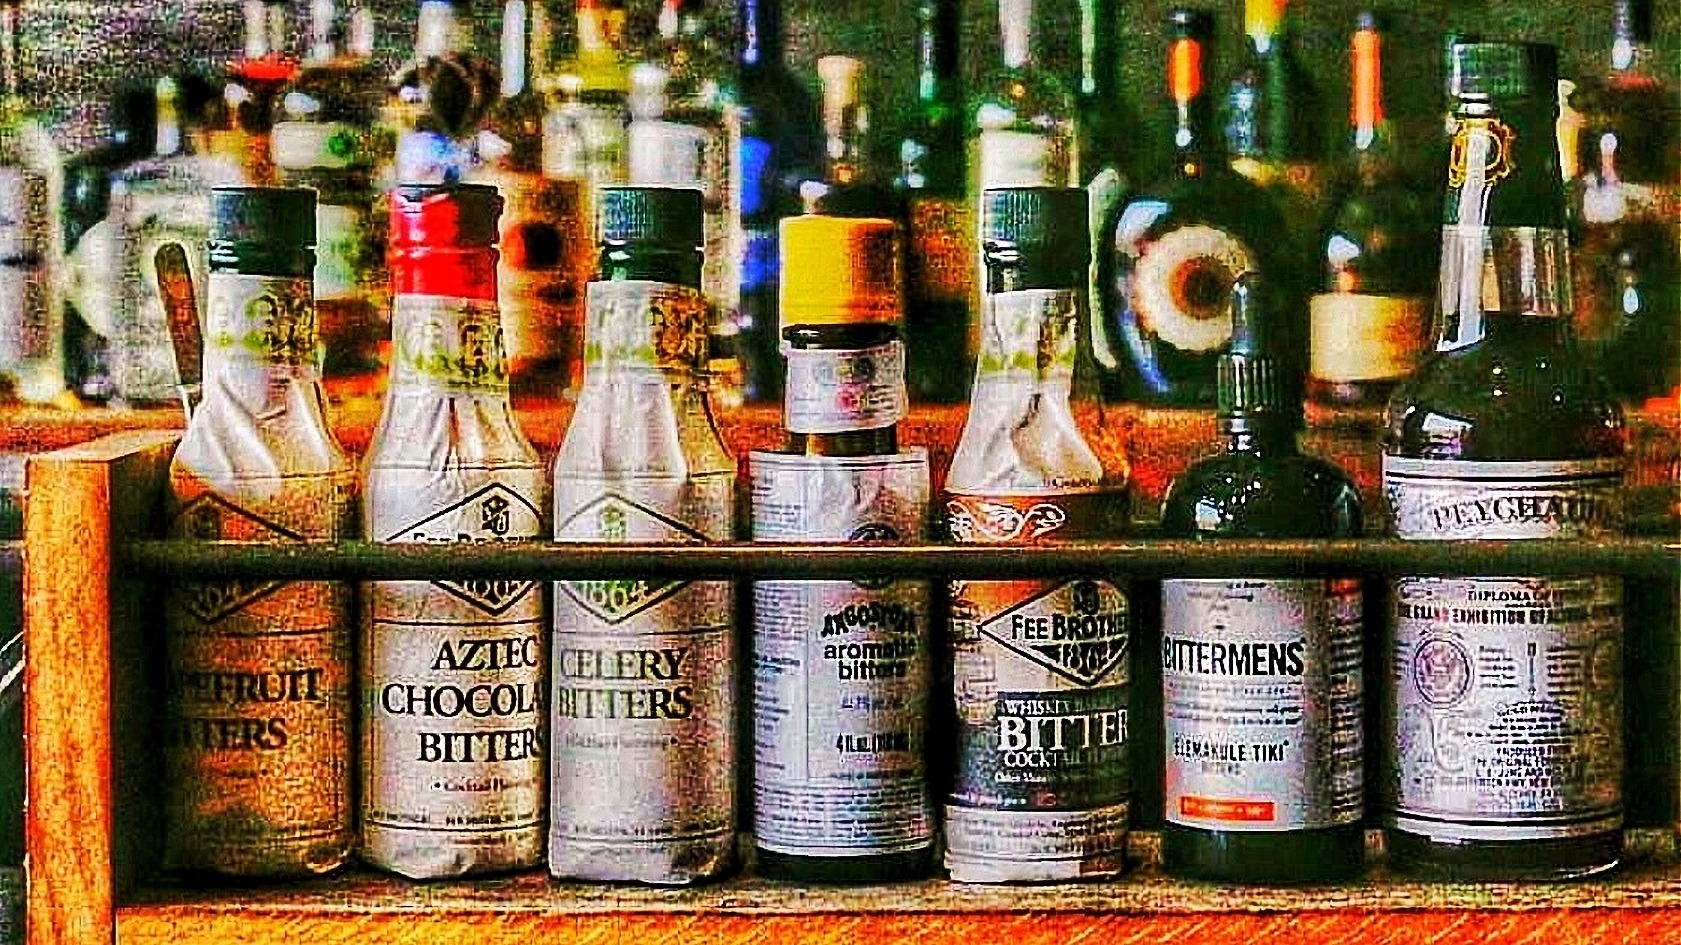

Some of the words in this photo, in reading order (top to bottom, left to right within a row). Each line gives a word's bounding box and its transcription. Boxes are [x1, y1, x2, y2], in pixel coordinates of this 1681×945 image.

[1011, 614, 1048, 640] FEE
[432, 635, 537, 671] AZTEC
[560, 648, 689, 681] CELERY
[1164, 638, 1305, 676] BITTERMENS
[381, 683, 538, 718] CHOCOL
[559, 686, 693, 719] BITTERS
